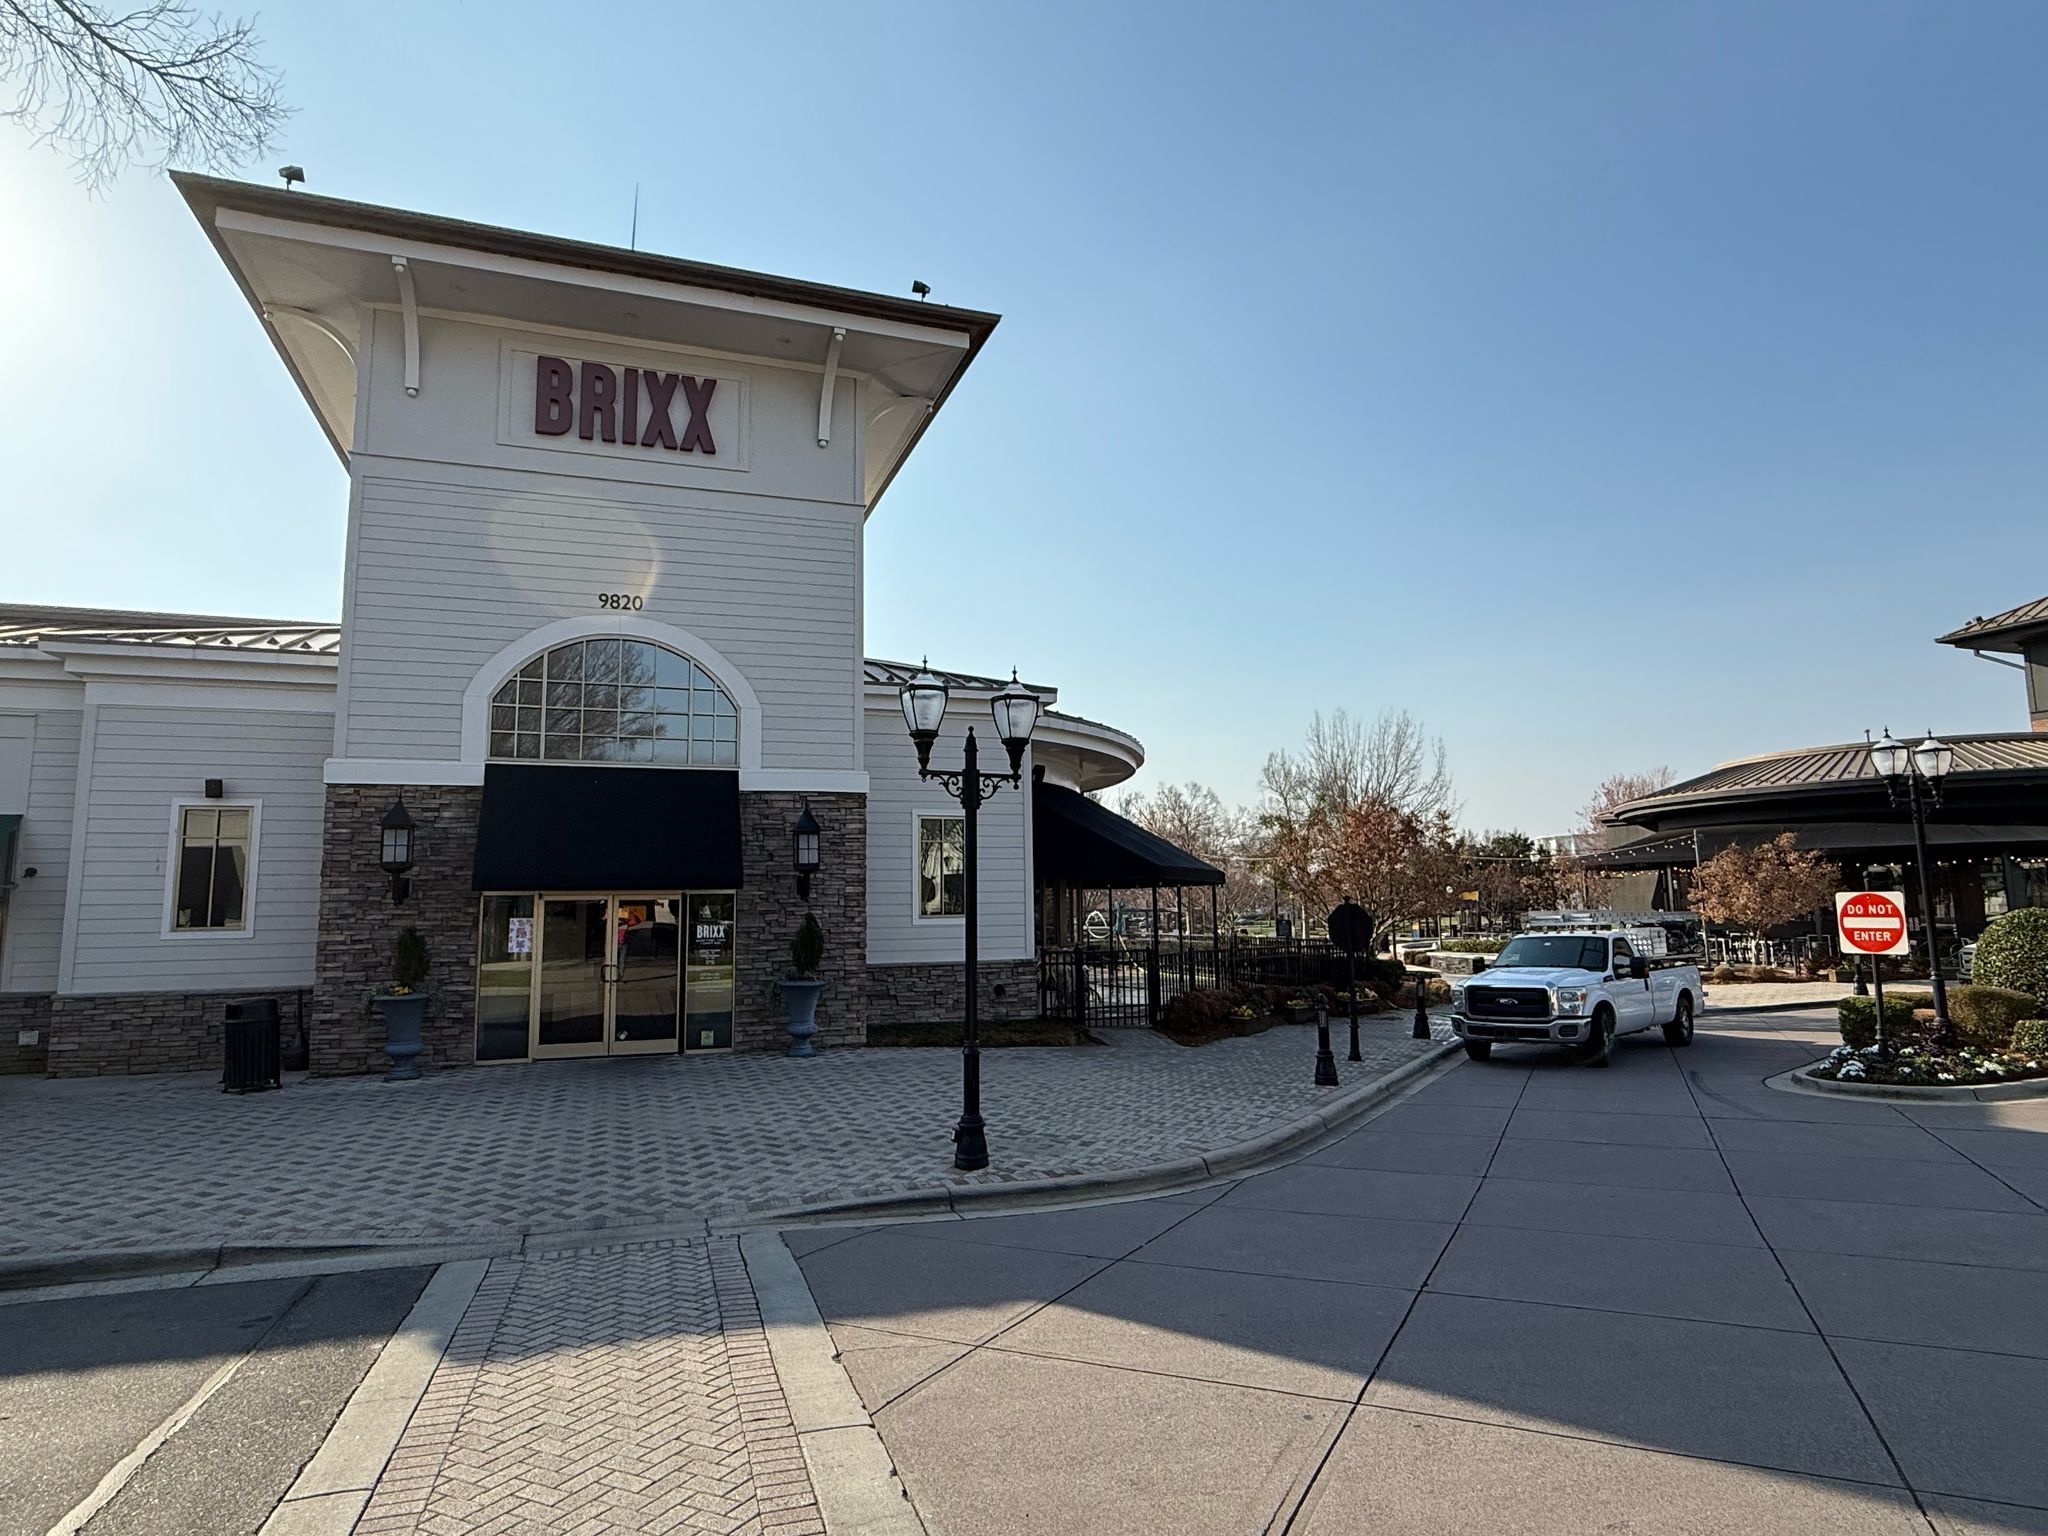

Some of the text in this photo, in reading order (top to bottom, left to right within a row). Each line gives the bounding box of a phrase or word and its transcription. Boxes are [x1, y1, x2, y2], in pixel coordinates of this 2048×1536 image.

[535, 355, 717, 454] BRIXX
[598, 593, 643, 611] 9820
[1847, 904, 1893, 915] DO NOT
[696, 925, 725, 938] BRIXX
[1853, 930, 1892, 942] ENTER
